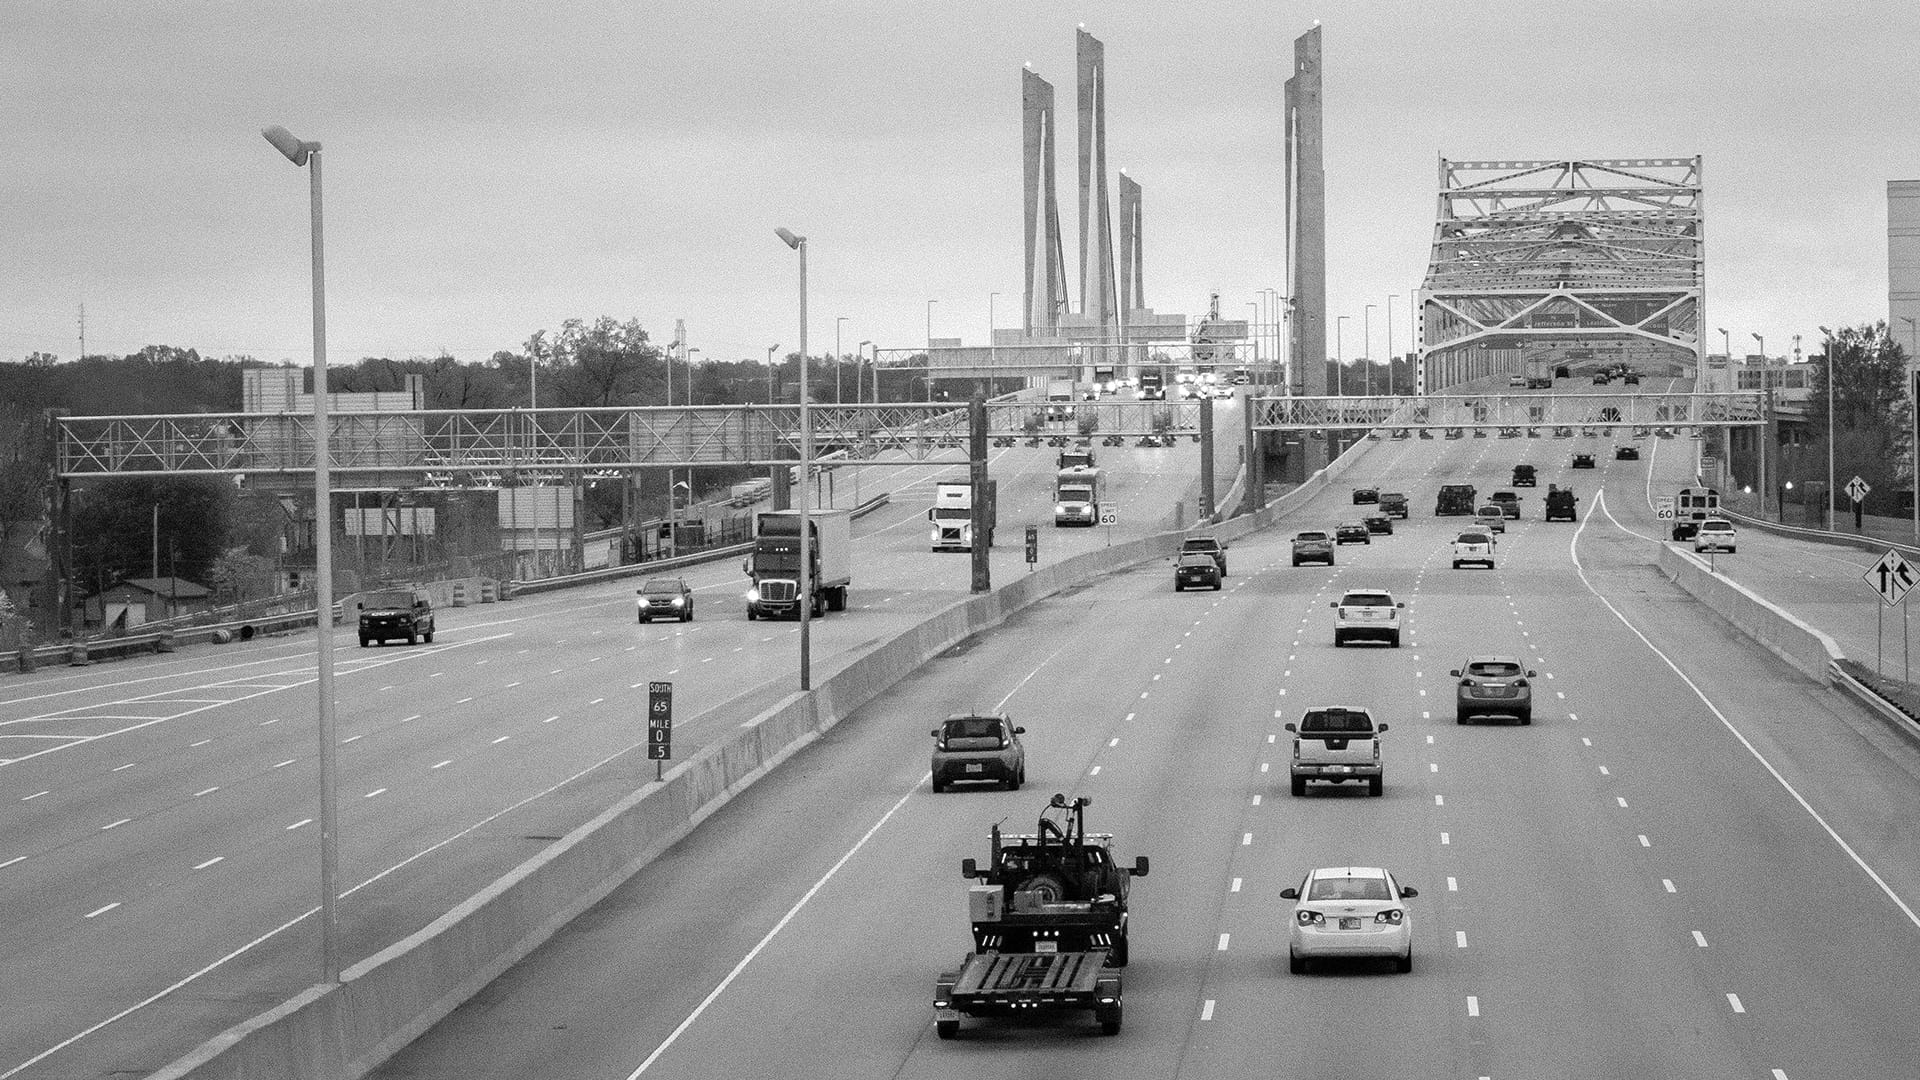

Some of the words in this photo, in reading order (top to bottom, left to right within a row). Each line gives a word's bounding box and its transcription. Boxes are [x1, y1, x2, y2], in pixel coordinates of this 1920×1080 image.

[1101, 514, 1116, 523] 60
[1658, 510, 1672, 519] 60
[650, 683, 671, 693] SOUTH
[653, 701, 668, 712] 65
[650, 719, 670, 729] MILE
[655, 729, 663, 742] 0
